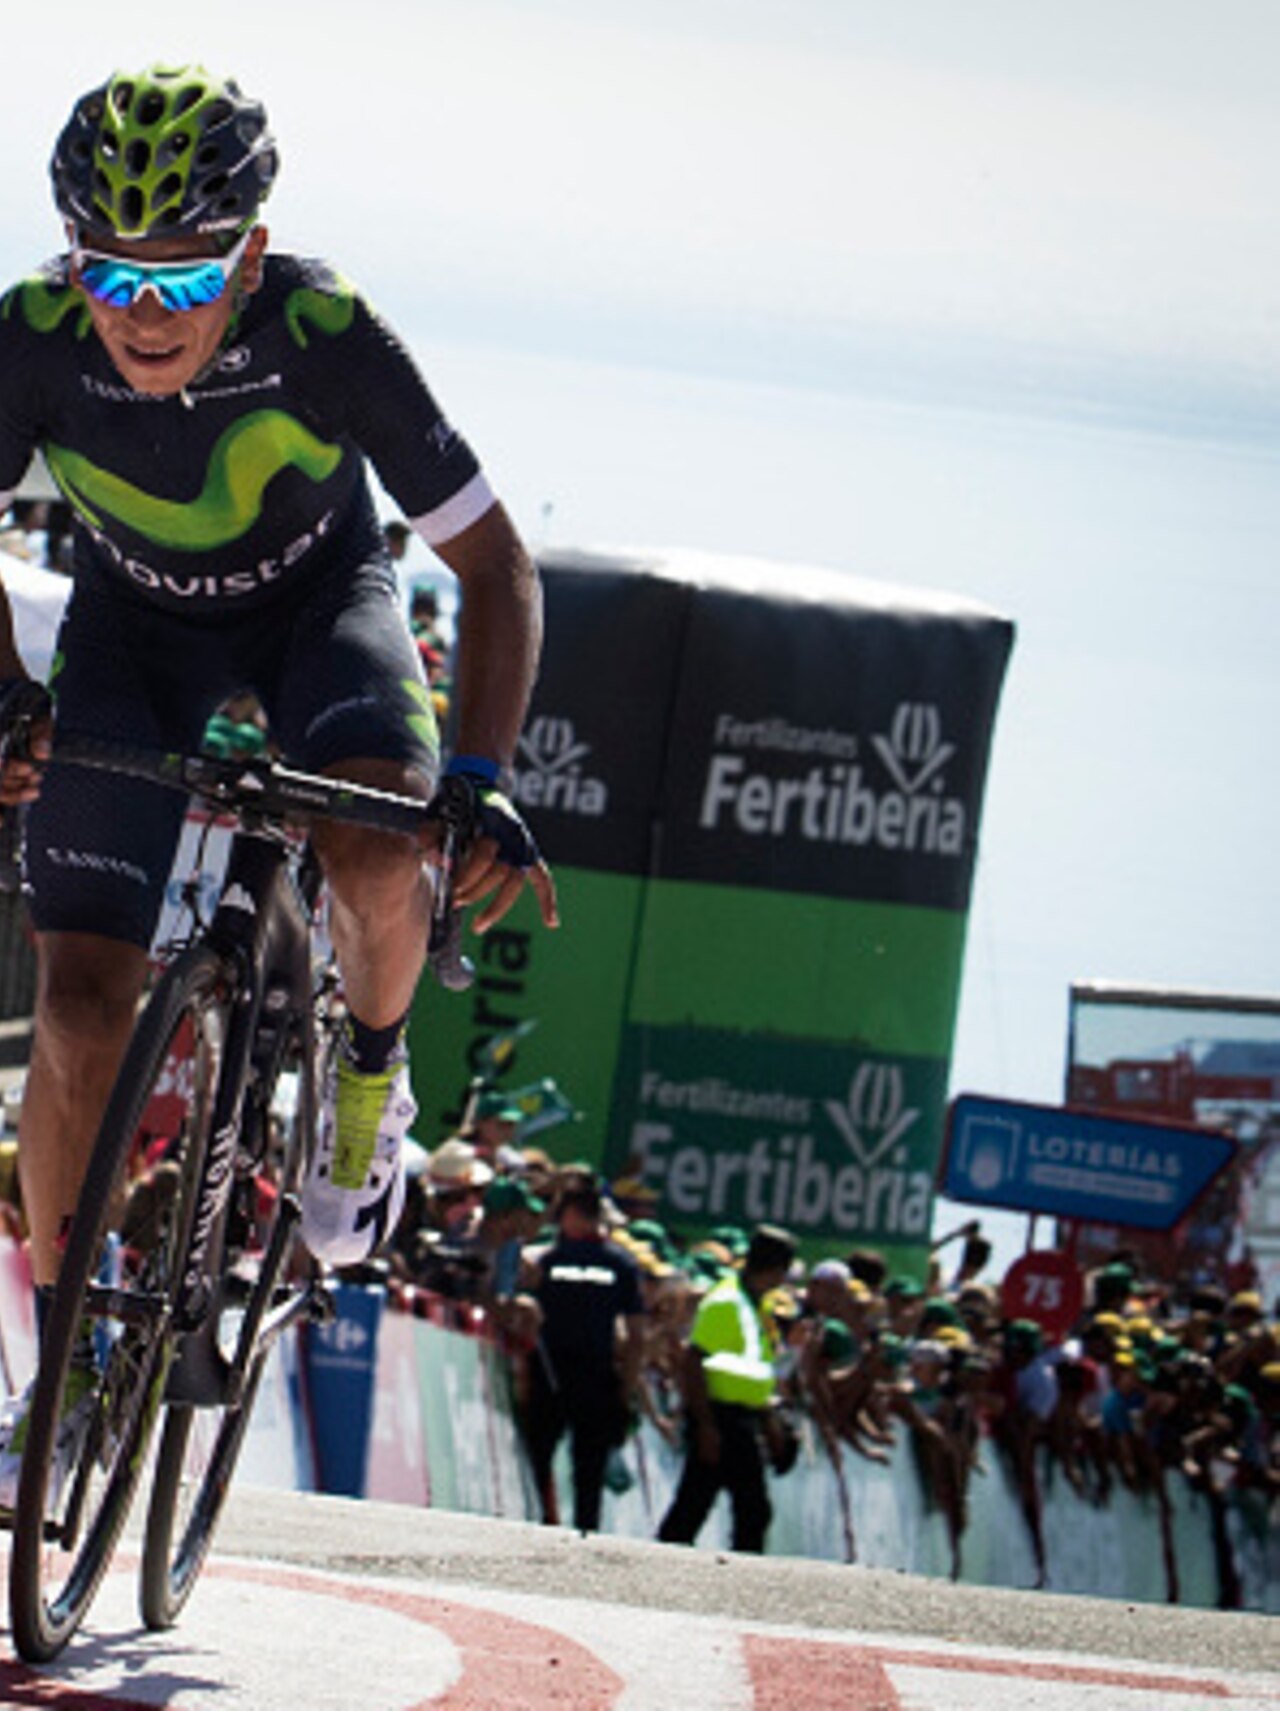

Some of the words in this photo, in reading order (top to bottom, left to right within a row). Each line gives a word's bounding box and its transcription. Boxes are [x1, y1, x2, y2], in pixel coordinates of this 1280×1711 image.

[73, 508, 333, 597] movistar
[715, 714, 860, 758] Fertilizantes
[510, 763, 608, 816] eria
[698, 754, 966, 855] Fertiberia
[640, 1071, 812, 1122] Fertilizantes
[628, 1120, 933, 1236] Fertiberia
[1024, 1272, 1063, 1310] 75
